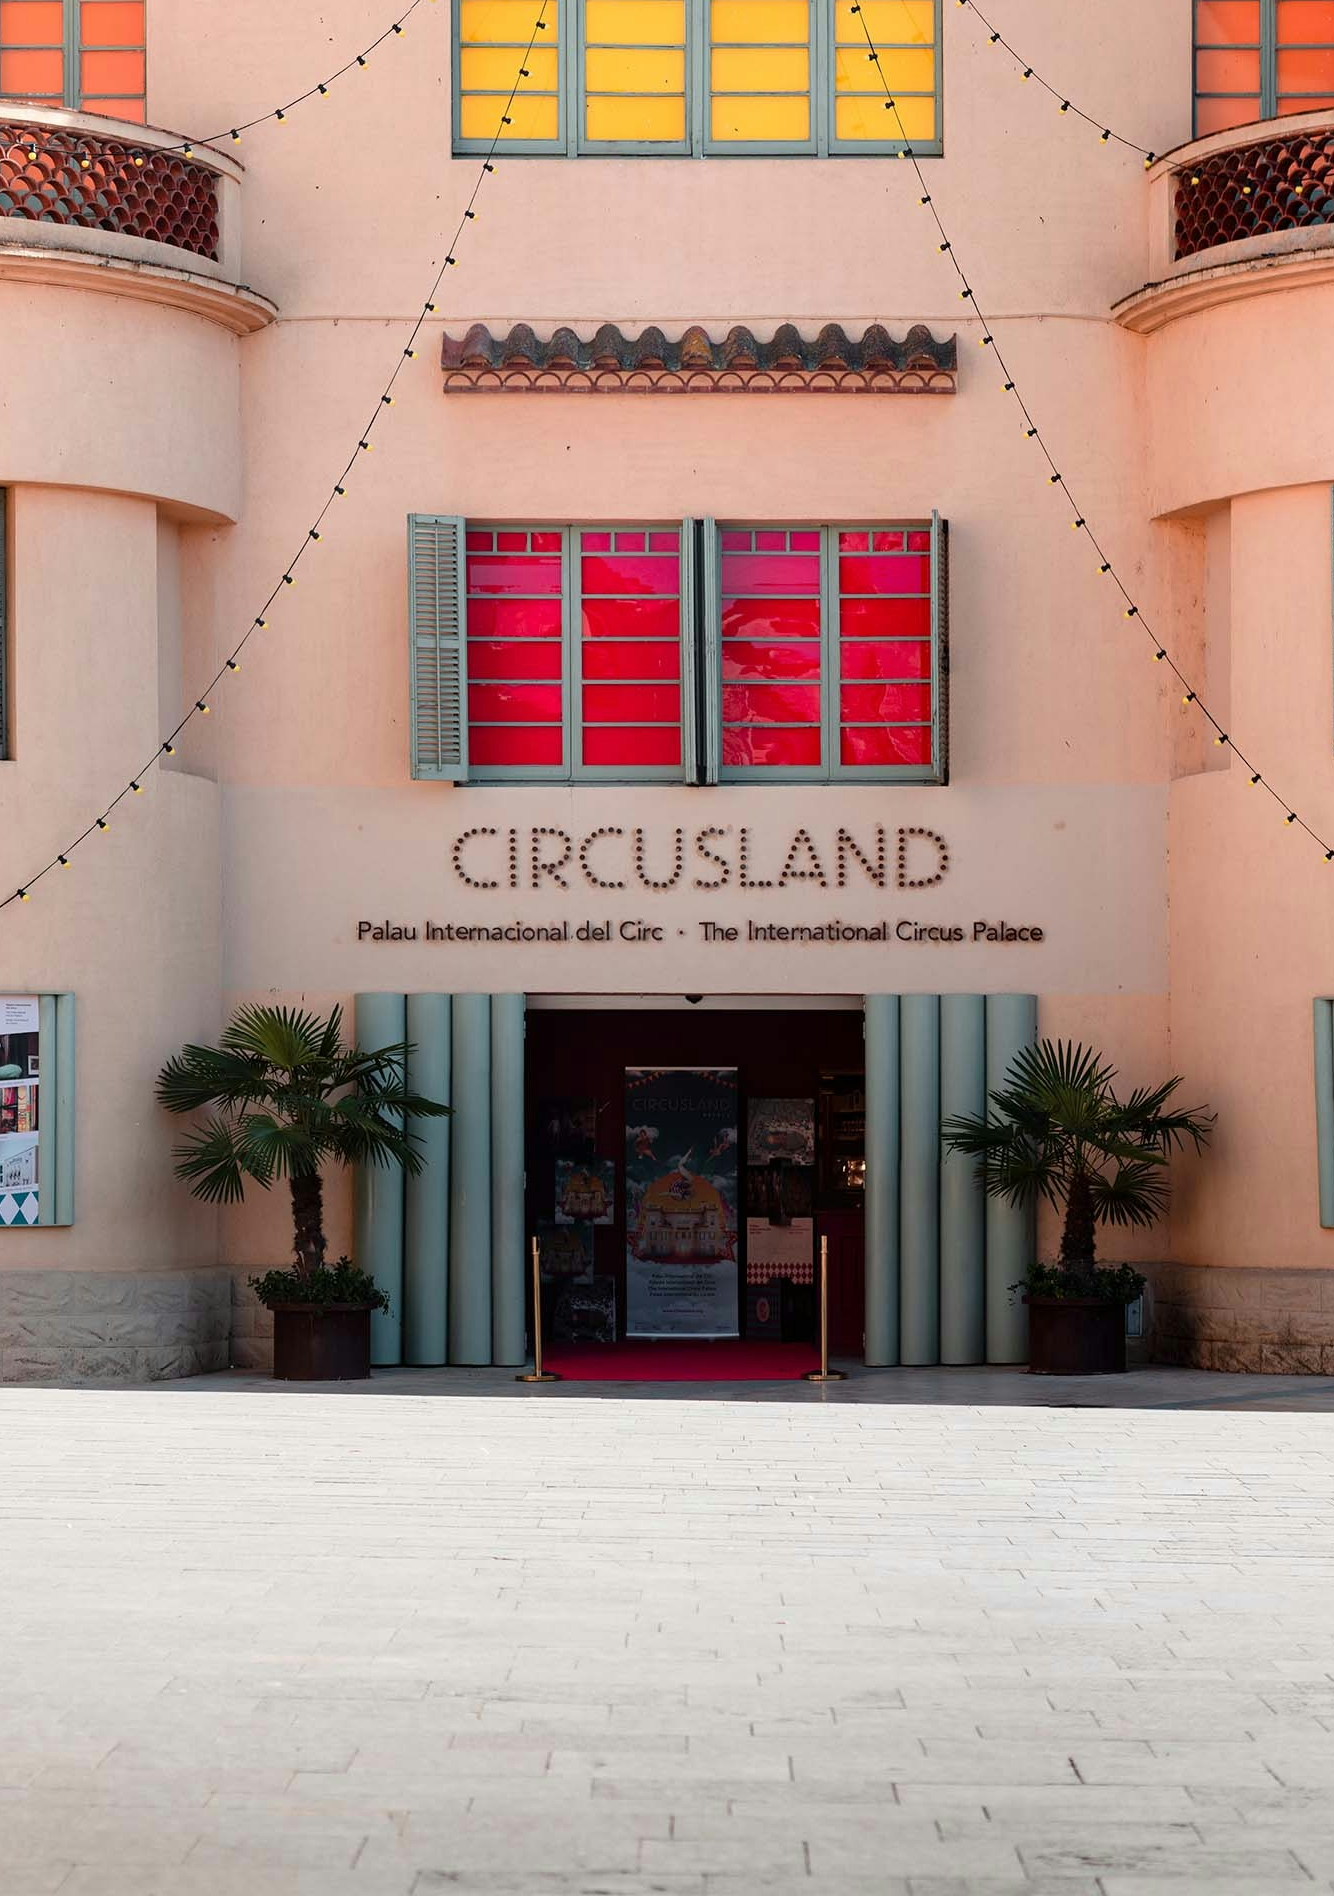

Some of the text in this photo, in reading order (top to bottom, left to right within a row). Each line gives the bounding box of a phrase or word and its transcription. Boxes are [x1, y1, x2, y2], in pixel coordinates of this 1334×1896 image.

[453, 827, 949, 888] CIRCUSLAND
[357, 920, 1044, 941] Palau Internacional del Circ The International Circus Palace
